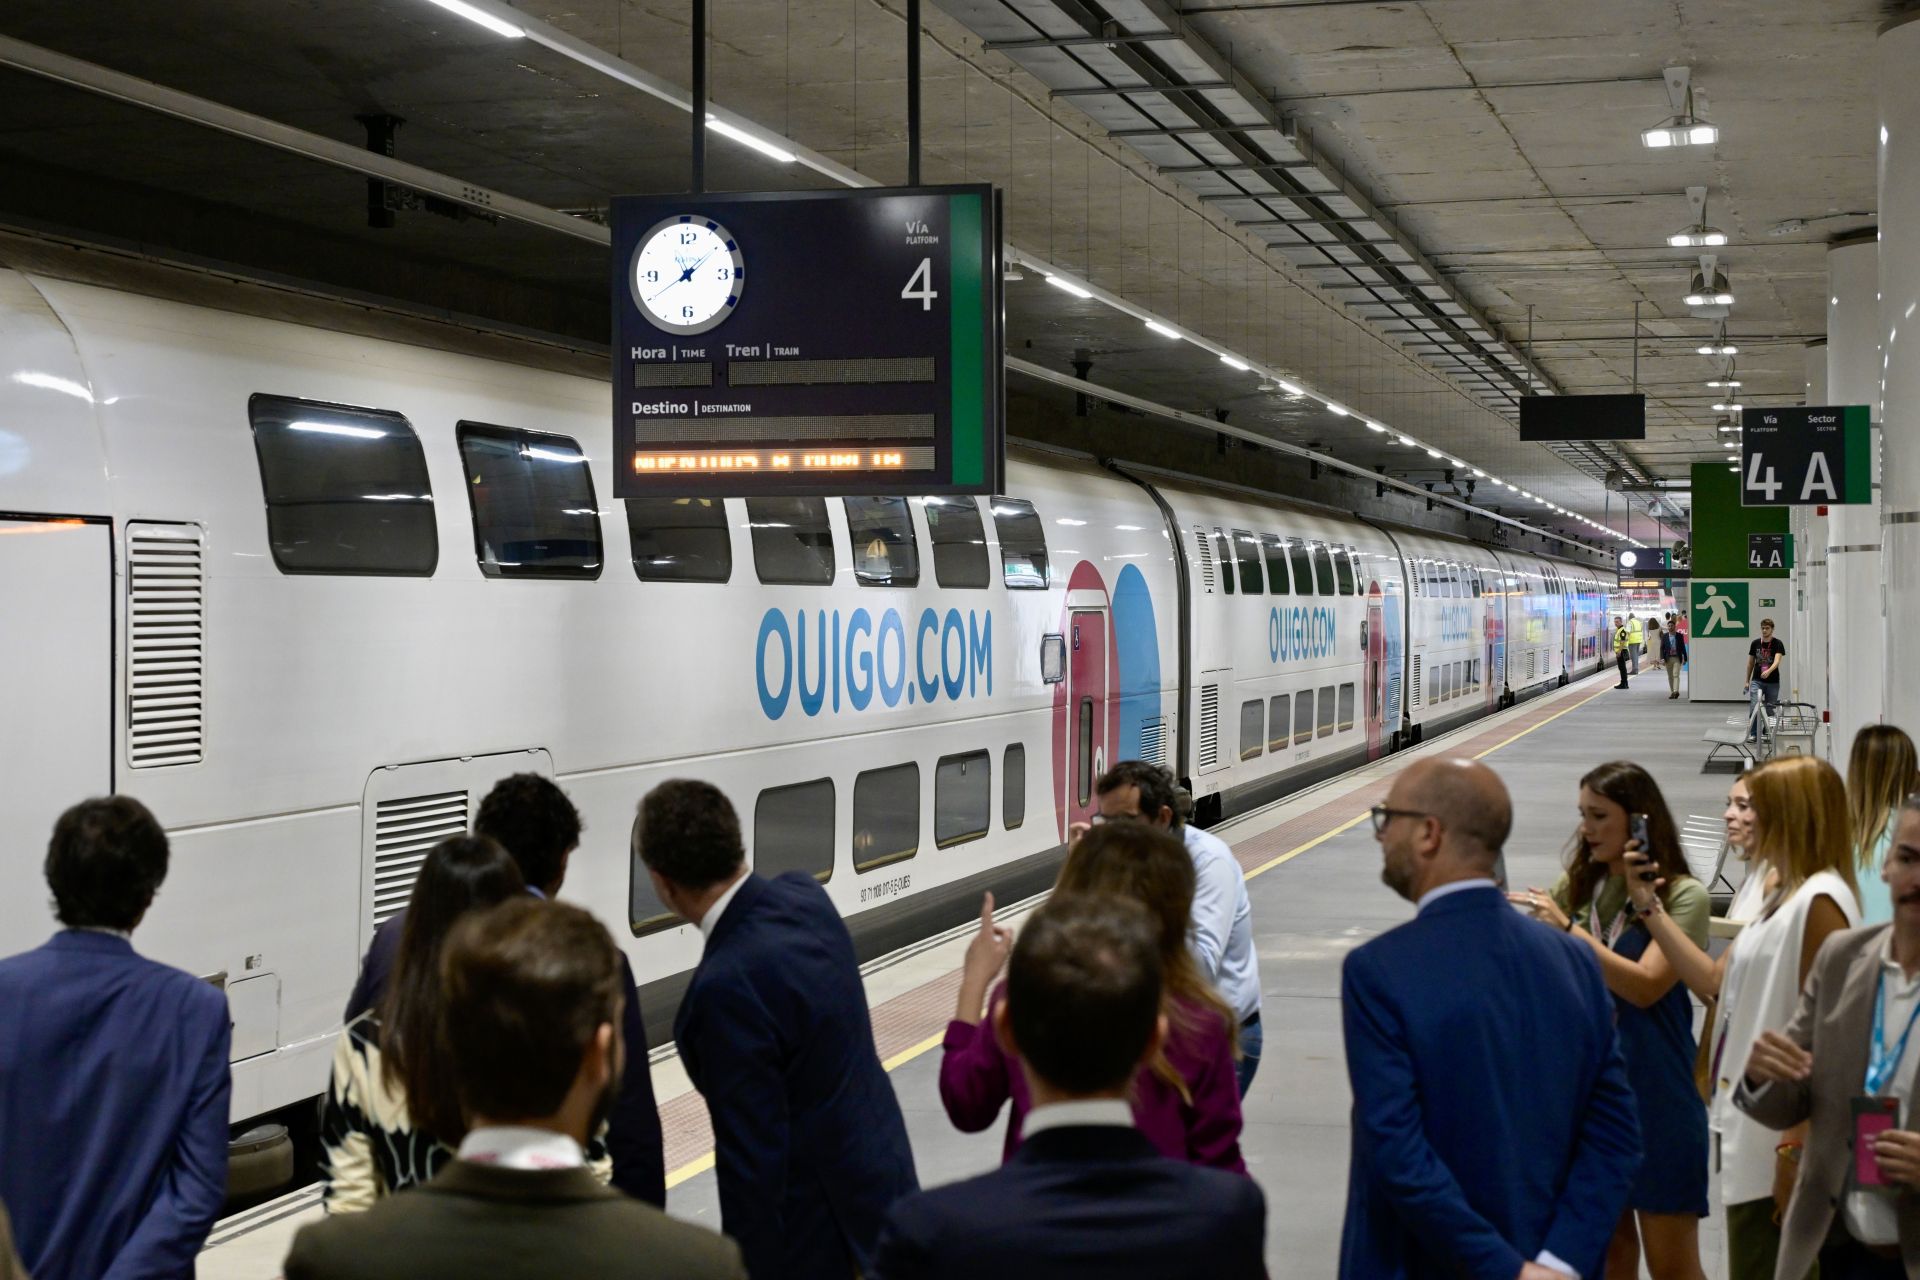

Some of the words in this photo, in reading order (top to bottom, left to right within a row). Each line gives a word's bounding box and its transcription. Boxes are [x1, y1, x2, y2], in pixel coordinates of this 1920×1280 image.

[905, 220, 928, 234] Vía
[680, 232, 697, 245] 12
[906, 235, 939, 245] PLATFORM
[647, 270, 659, 282] 9
[717, 268, 729, 280] 3
[901, 257, 938, 311] 4
[682, 306, 694, 318] 6
[631, 346, 666, 359] Hora
[681, 349, 706, 358] TIME
[725, 344, 760, 357] Tren
[773, 347, 800, 356] TRAIN
[632, 401, 689, 414] Destino
[701, 404, 751, 413] DESTINATION
[1763, 415, 1778, 424] Vía
[1807, 415, 1836, 424] Sector
[1746, 452, 1783, 501] 4
[1799, 451, 1838, 500] A
[1658, 556, 1665, 565] 4
[1750, 549, 1763, 568] 4
[1768, 549, 1782, 568] A
[1269, 606, 1336, 664] OUIGO.COM
[755, 607, 993, 721] OUIGO.COM
